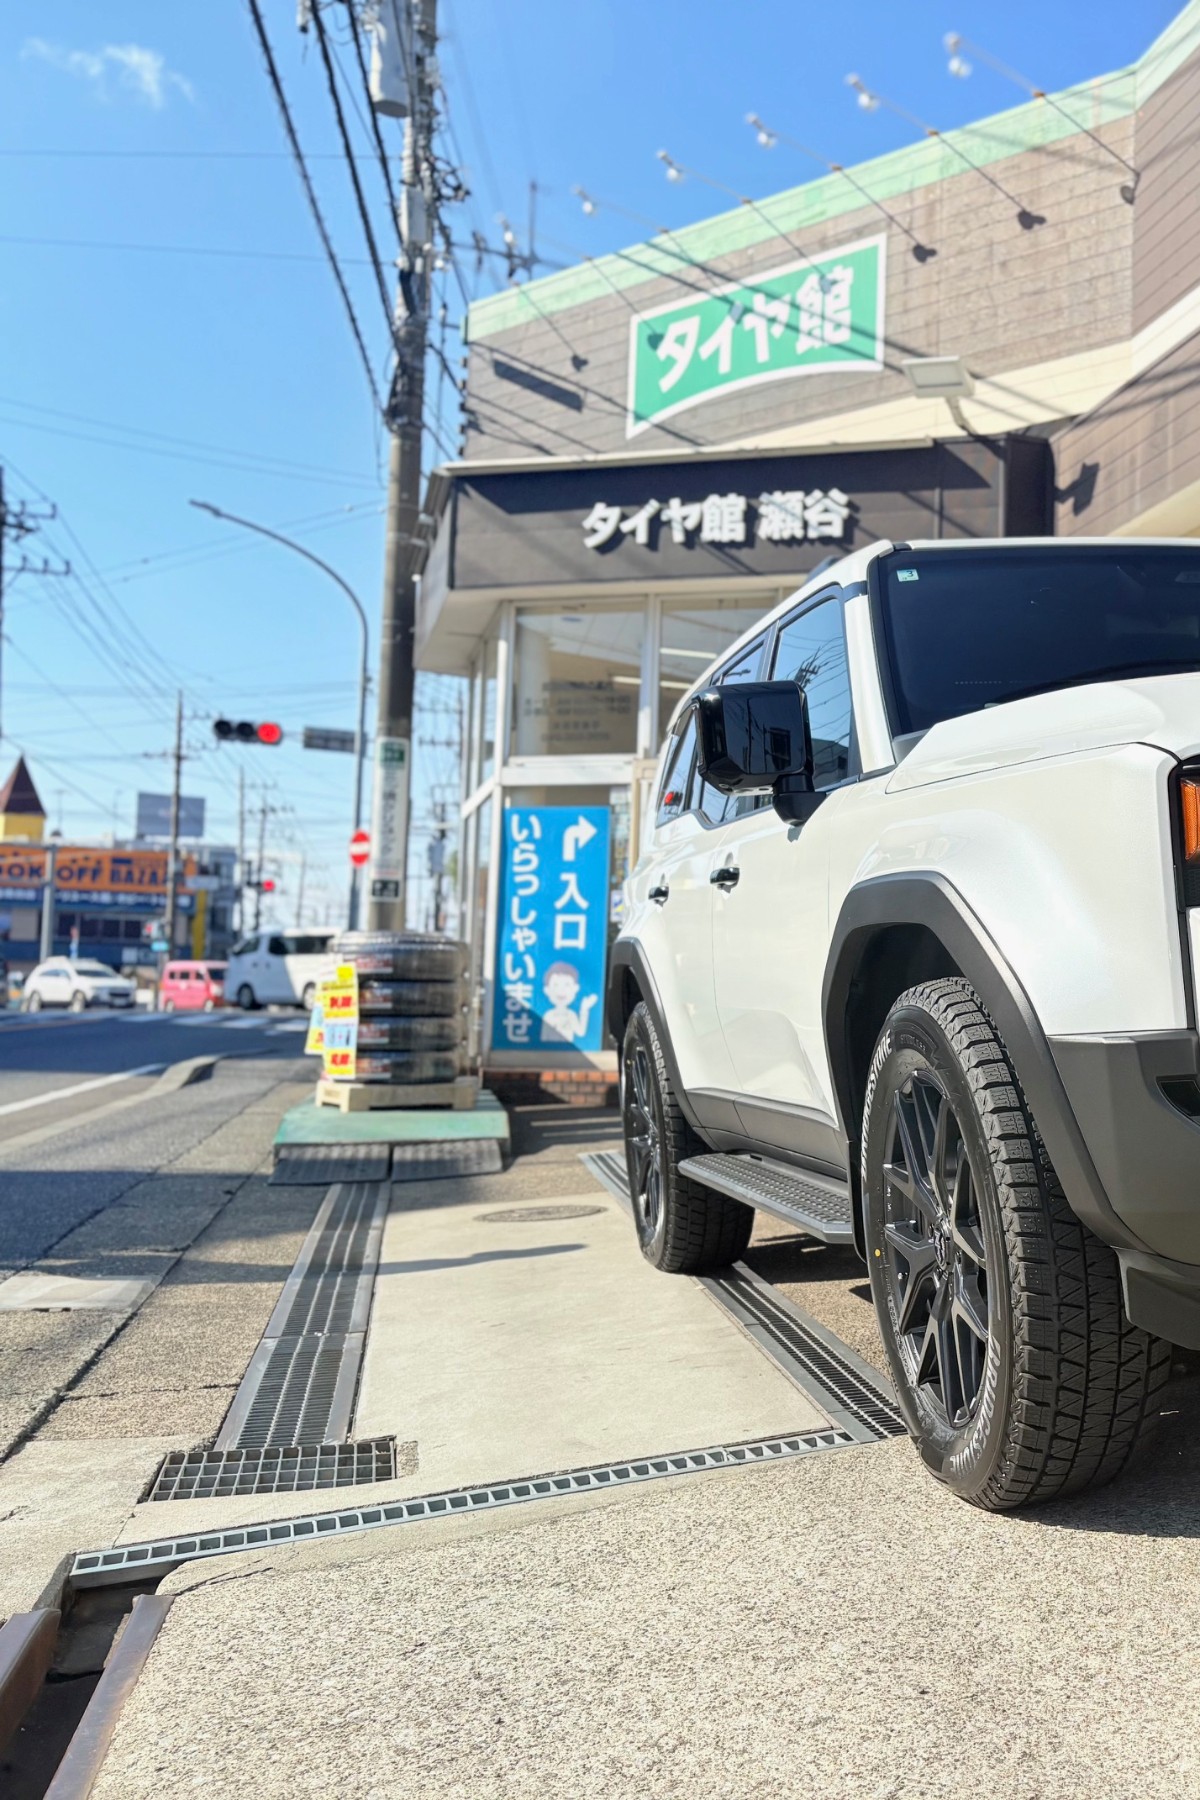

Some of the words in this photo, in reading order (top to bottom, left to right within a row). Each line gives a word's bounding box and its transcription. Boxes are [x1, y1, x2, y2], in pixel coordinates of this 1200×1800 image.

[657, 265, 854, 393] タイヤ館
[582, 493, 747, 548] タイヤ館
[758, 488, 849, 540] 瀬谷
[56, 862, 103, 883] OFF
[502, 813, 542, 1043] いらっしゃいませ
[553, 872, 589, 950] 入口
[861, 1029, 892, 1183] BRIDGESTONE
[949, 1335, 1000, 1480] BRIDGESTONE
